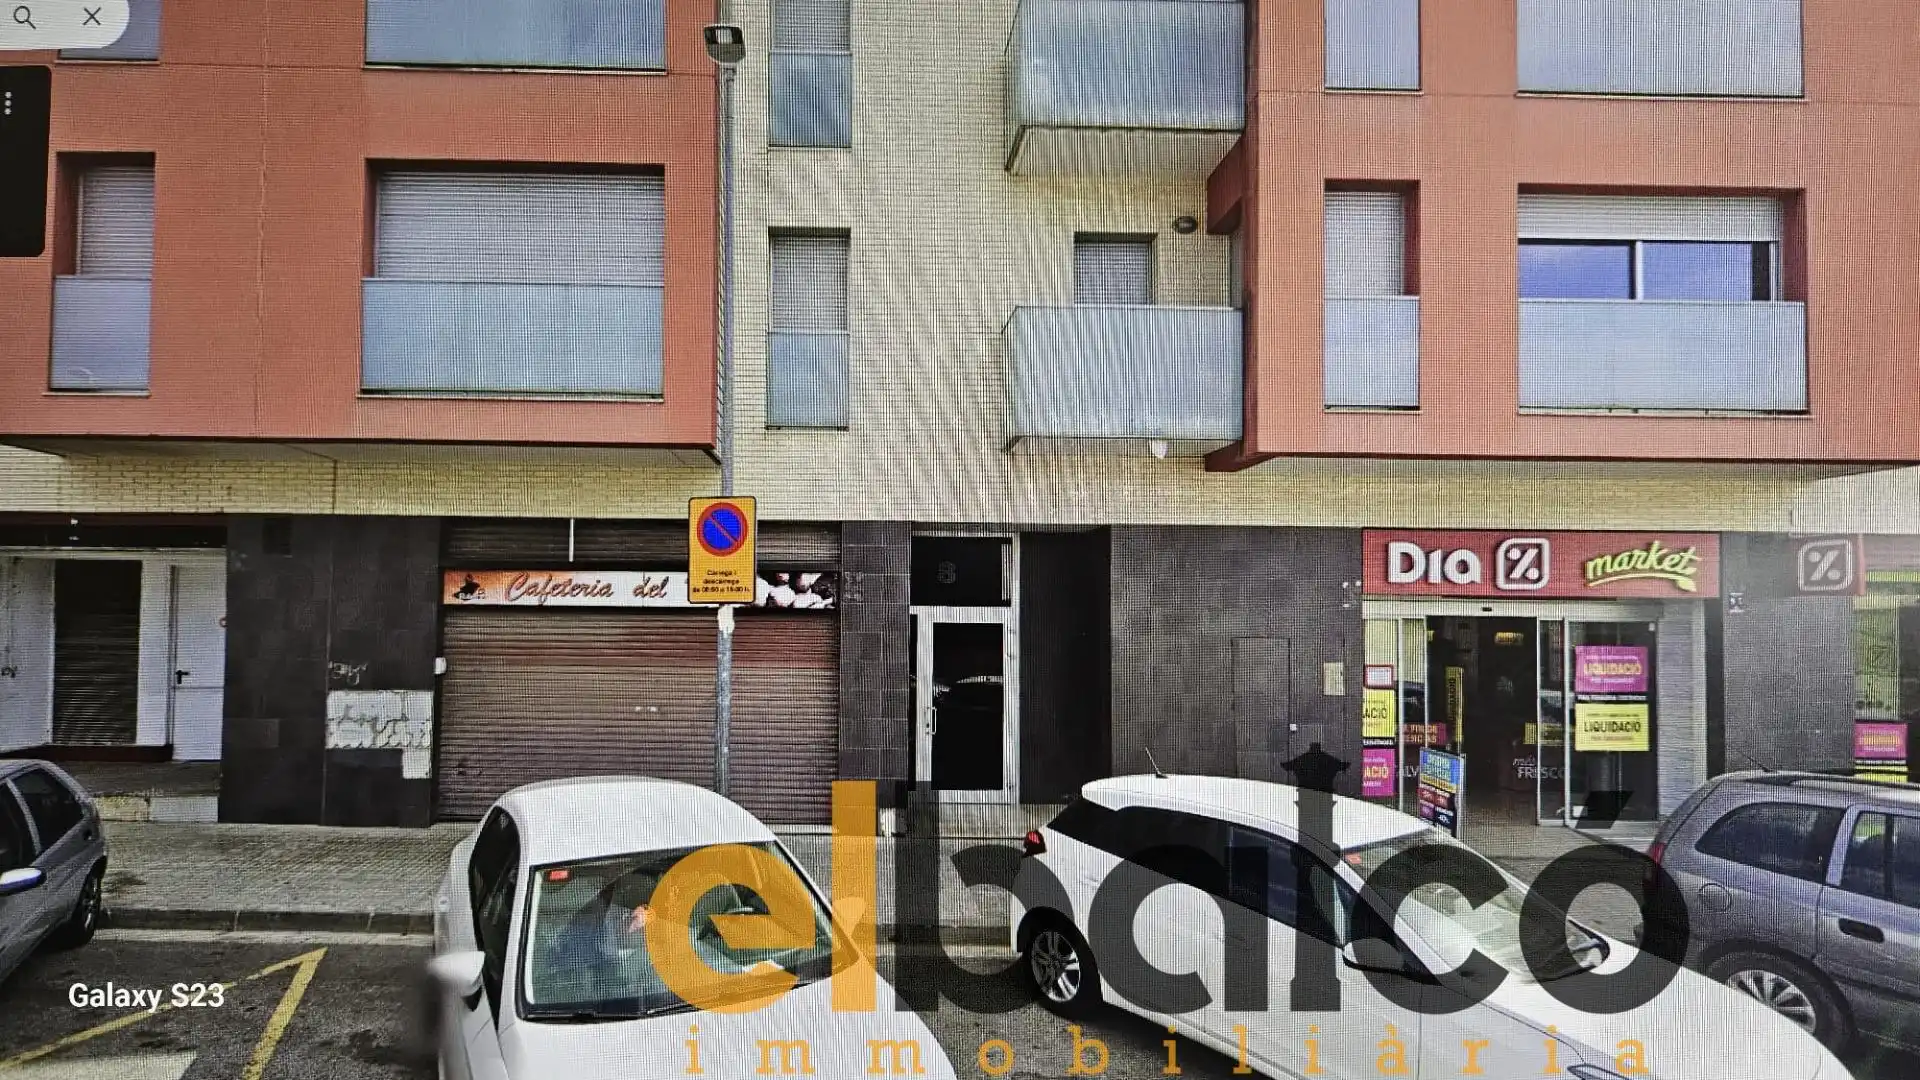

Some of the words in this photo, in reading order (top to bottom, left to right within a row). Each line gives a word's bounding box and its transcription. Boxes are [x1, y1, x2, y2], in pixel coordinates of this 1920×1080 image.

[1585, 540, 1700, 581] market
[504, 570, 615, 606] Cafeteria
[632, 573, 670, 599] del
